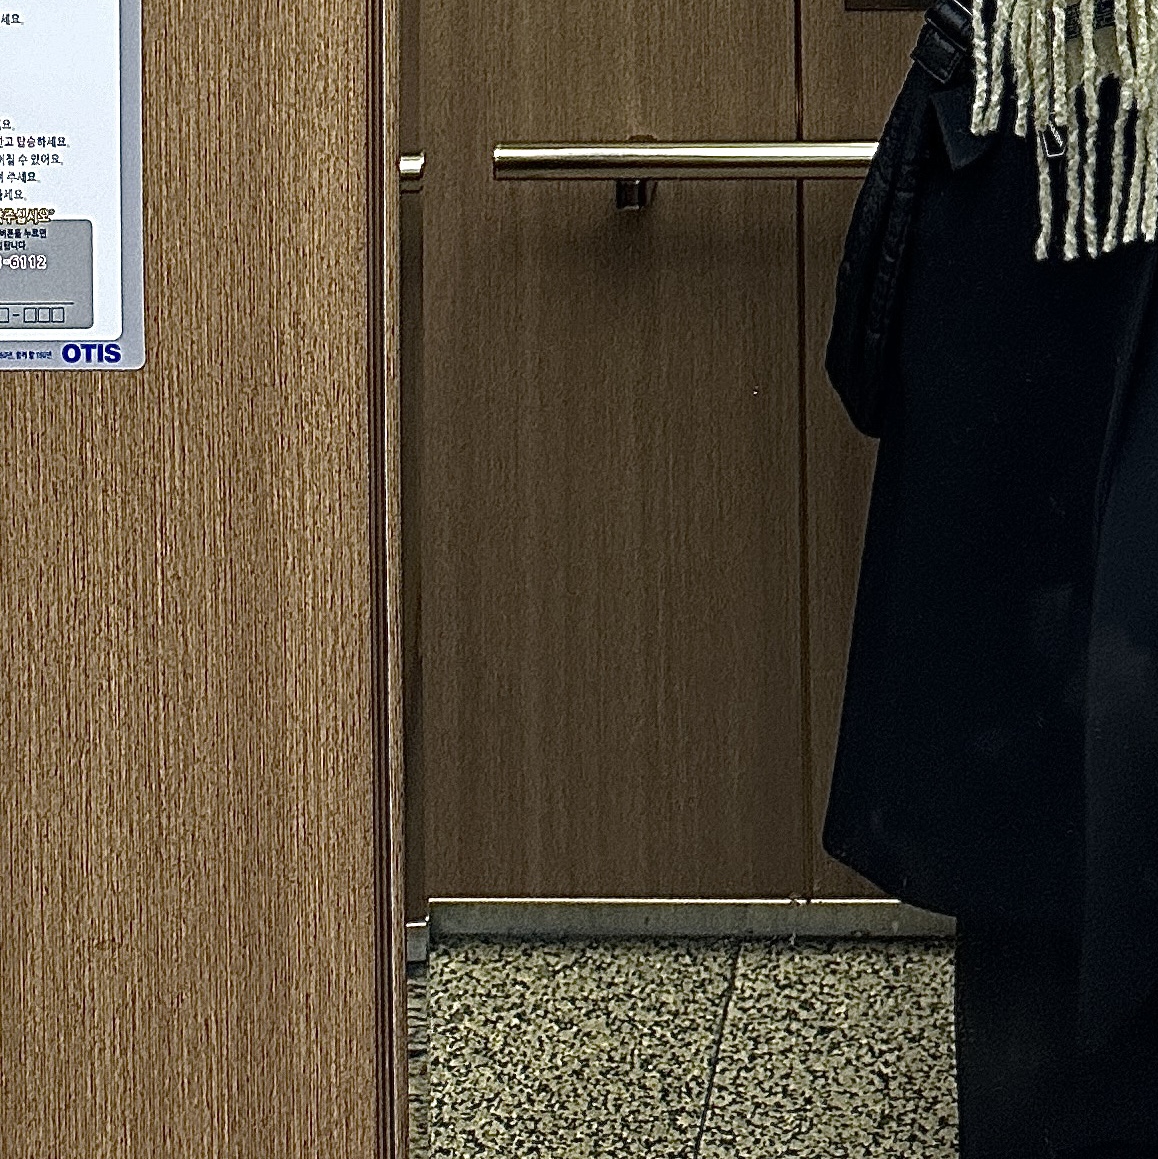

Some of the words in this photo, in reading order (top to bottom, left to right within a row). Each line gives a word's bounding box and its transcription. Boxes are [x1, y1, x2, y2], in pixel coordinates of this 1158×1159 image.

[0, 119, 15, 131] 요.
[17, 136, 70, 148] 탑승하세요.
[18, 154, 28, 166] 수
[31, 154, 64, 166] 있어요.
[7, 171, 41, 183] 주세요.
[0, 189, 27, 201] 세요.
[24, 229, 47, 239] 누르면
[0, 254, 48, 270] -6112
[61, 343, 122, 364] OTIS
